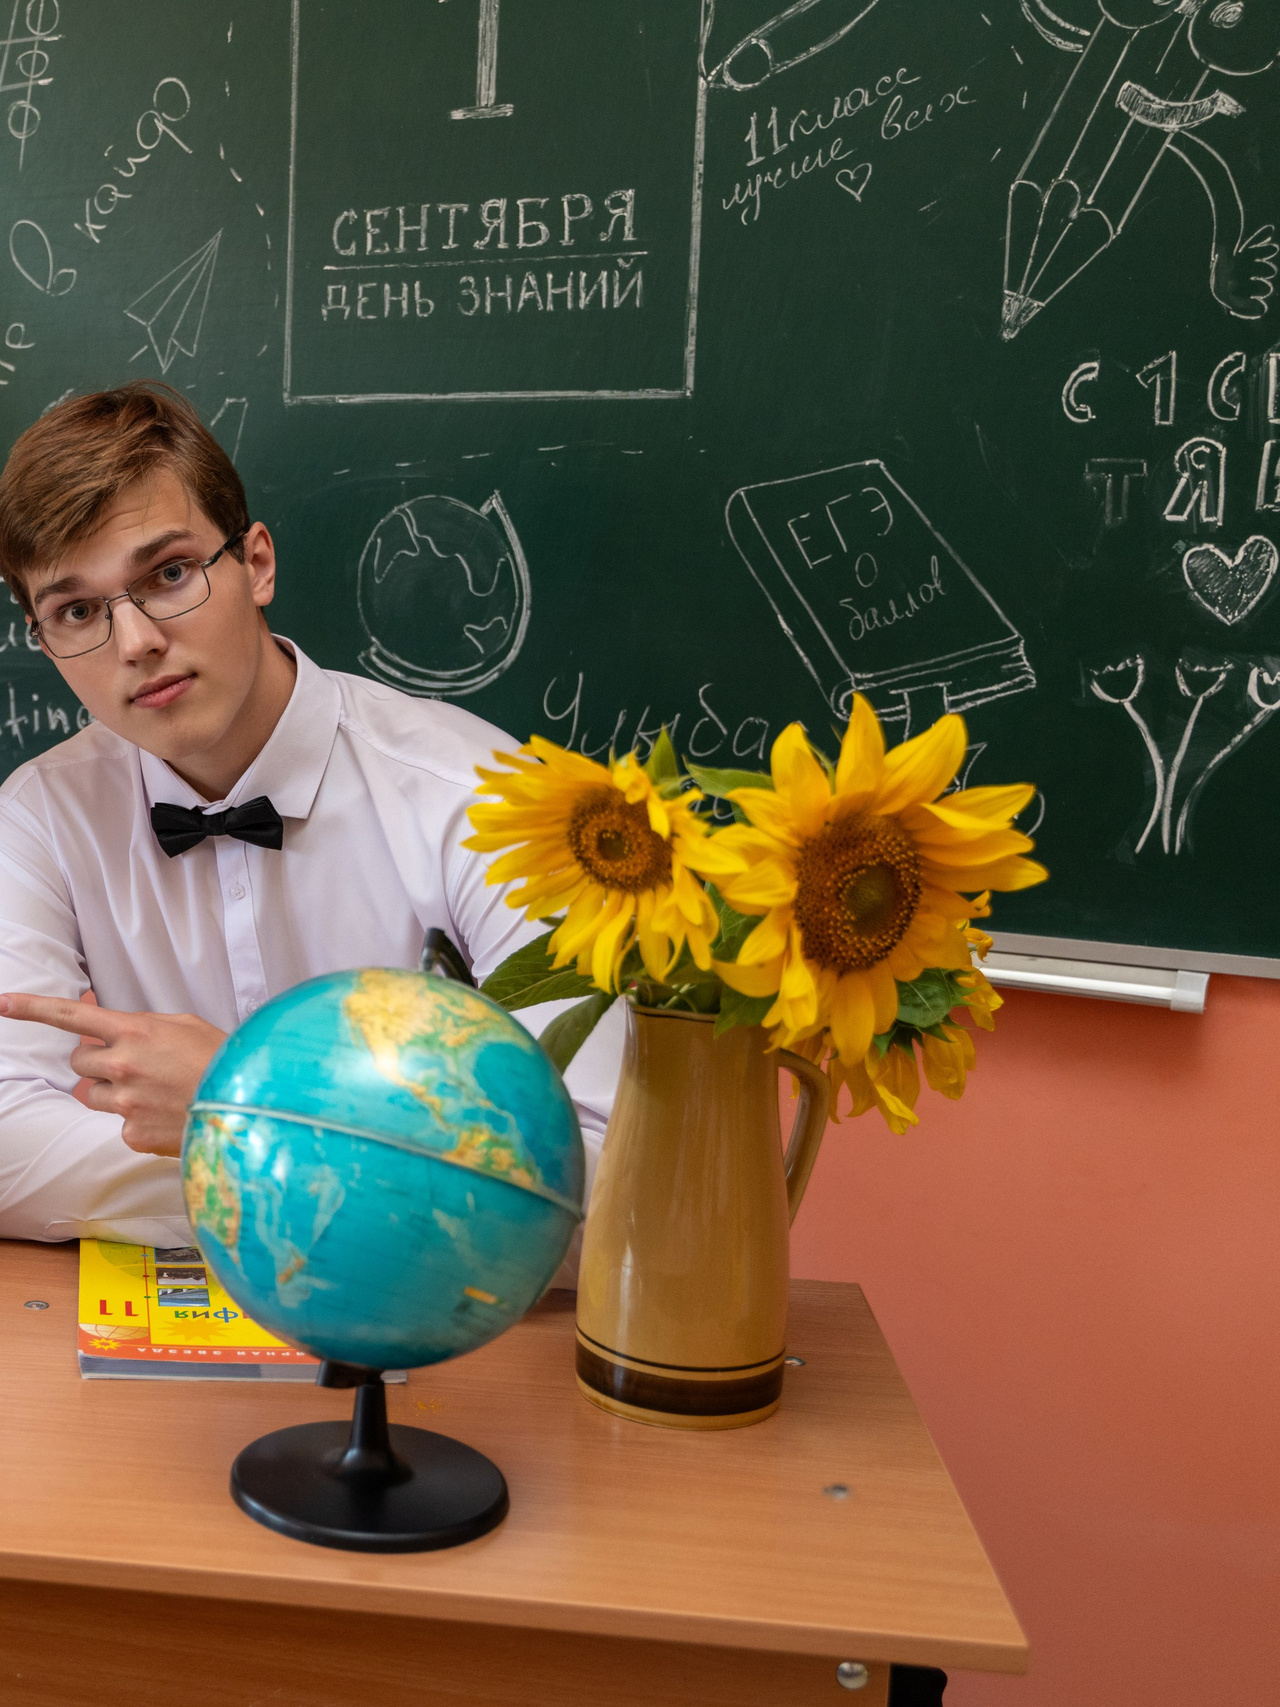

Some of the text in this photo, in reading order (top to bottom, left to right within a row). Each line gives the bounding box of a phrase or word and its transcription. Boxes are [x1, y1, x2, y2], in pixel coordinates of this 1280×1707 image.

[881, 85, 977, 140] всех
[332, 188, 638, 257] СЕНТЯБРЯ
[321, 257, 644, 321] ДЕНЬ ЗНАНИЙ
[787, 487, 894, 570] ЕГЭ
[839, 555, 948, 641] баллов
[543, 671, 808, 761] Улыба
[100, 1299, 139, 1316] 11
[174, 1307, 252, 1323] ФИЯ
[137, 1347, 222, 1355] ЗВЕЗДА
